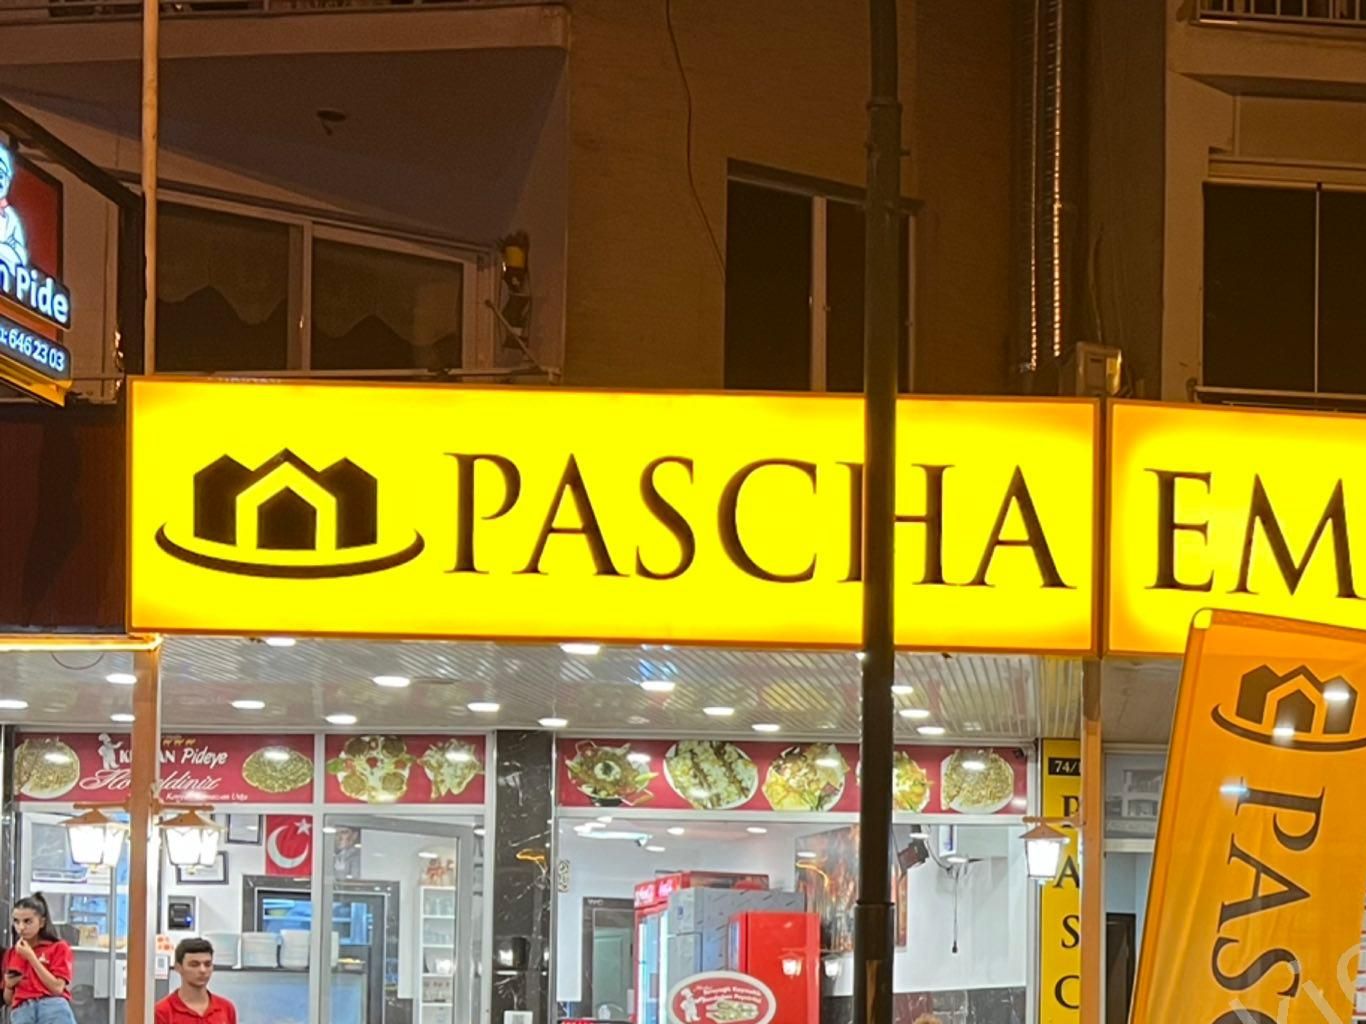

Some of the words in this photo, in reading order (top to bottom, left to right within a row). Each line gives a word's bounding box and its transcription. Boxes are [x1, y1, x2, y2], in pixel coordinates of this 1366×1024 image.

[15, 265, 69, 323] Pide
[8, 327, 32, 356] 646
[32, 340, 48, 364] 23
[49, 347, 65, 372] 03
[444, 453, 1078, 589] PASCHA
[180, 746, 229, 769] Pideye
